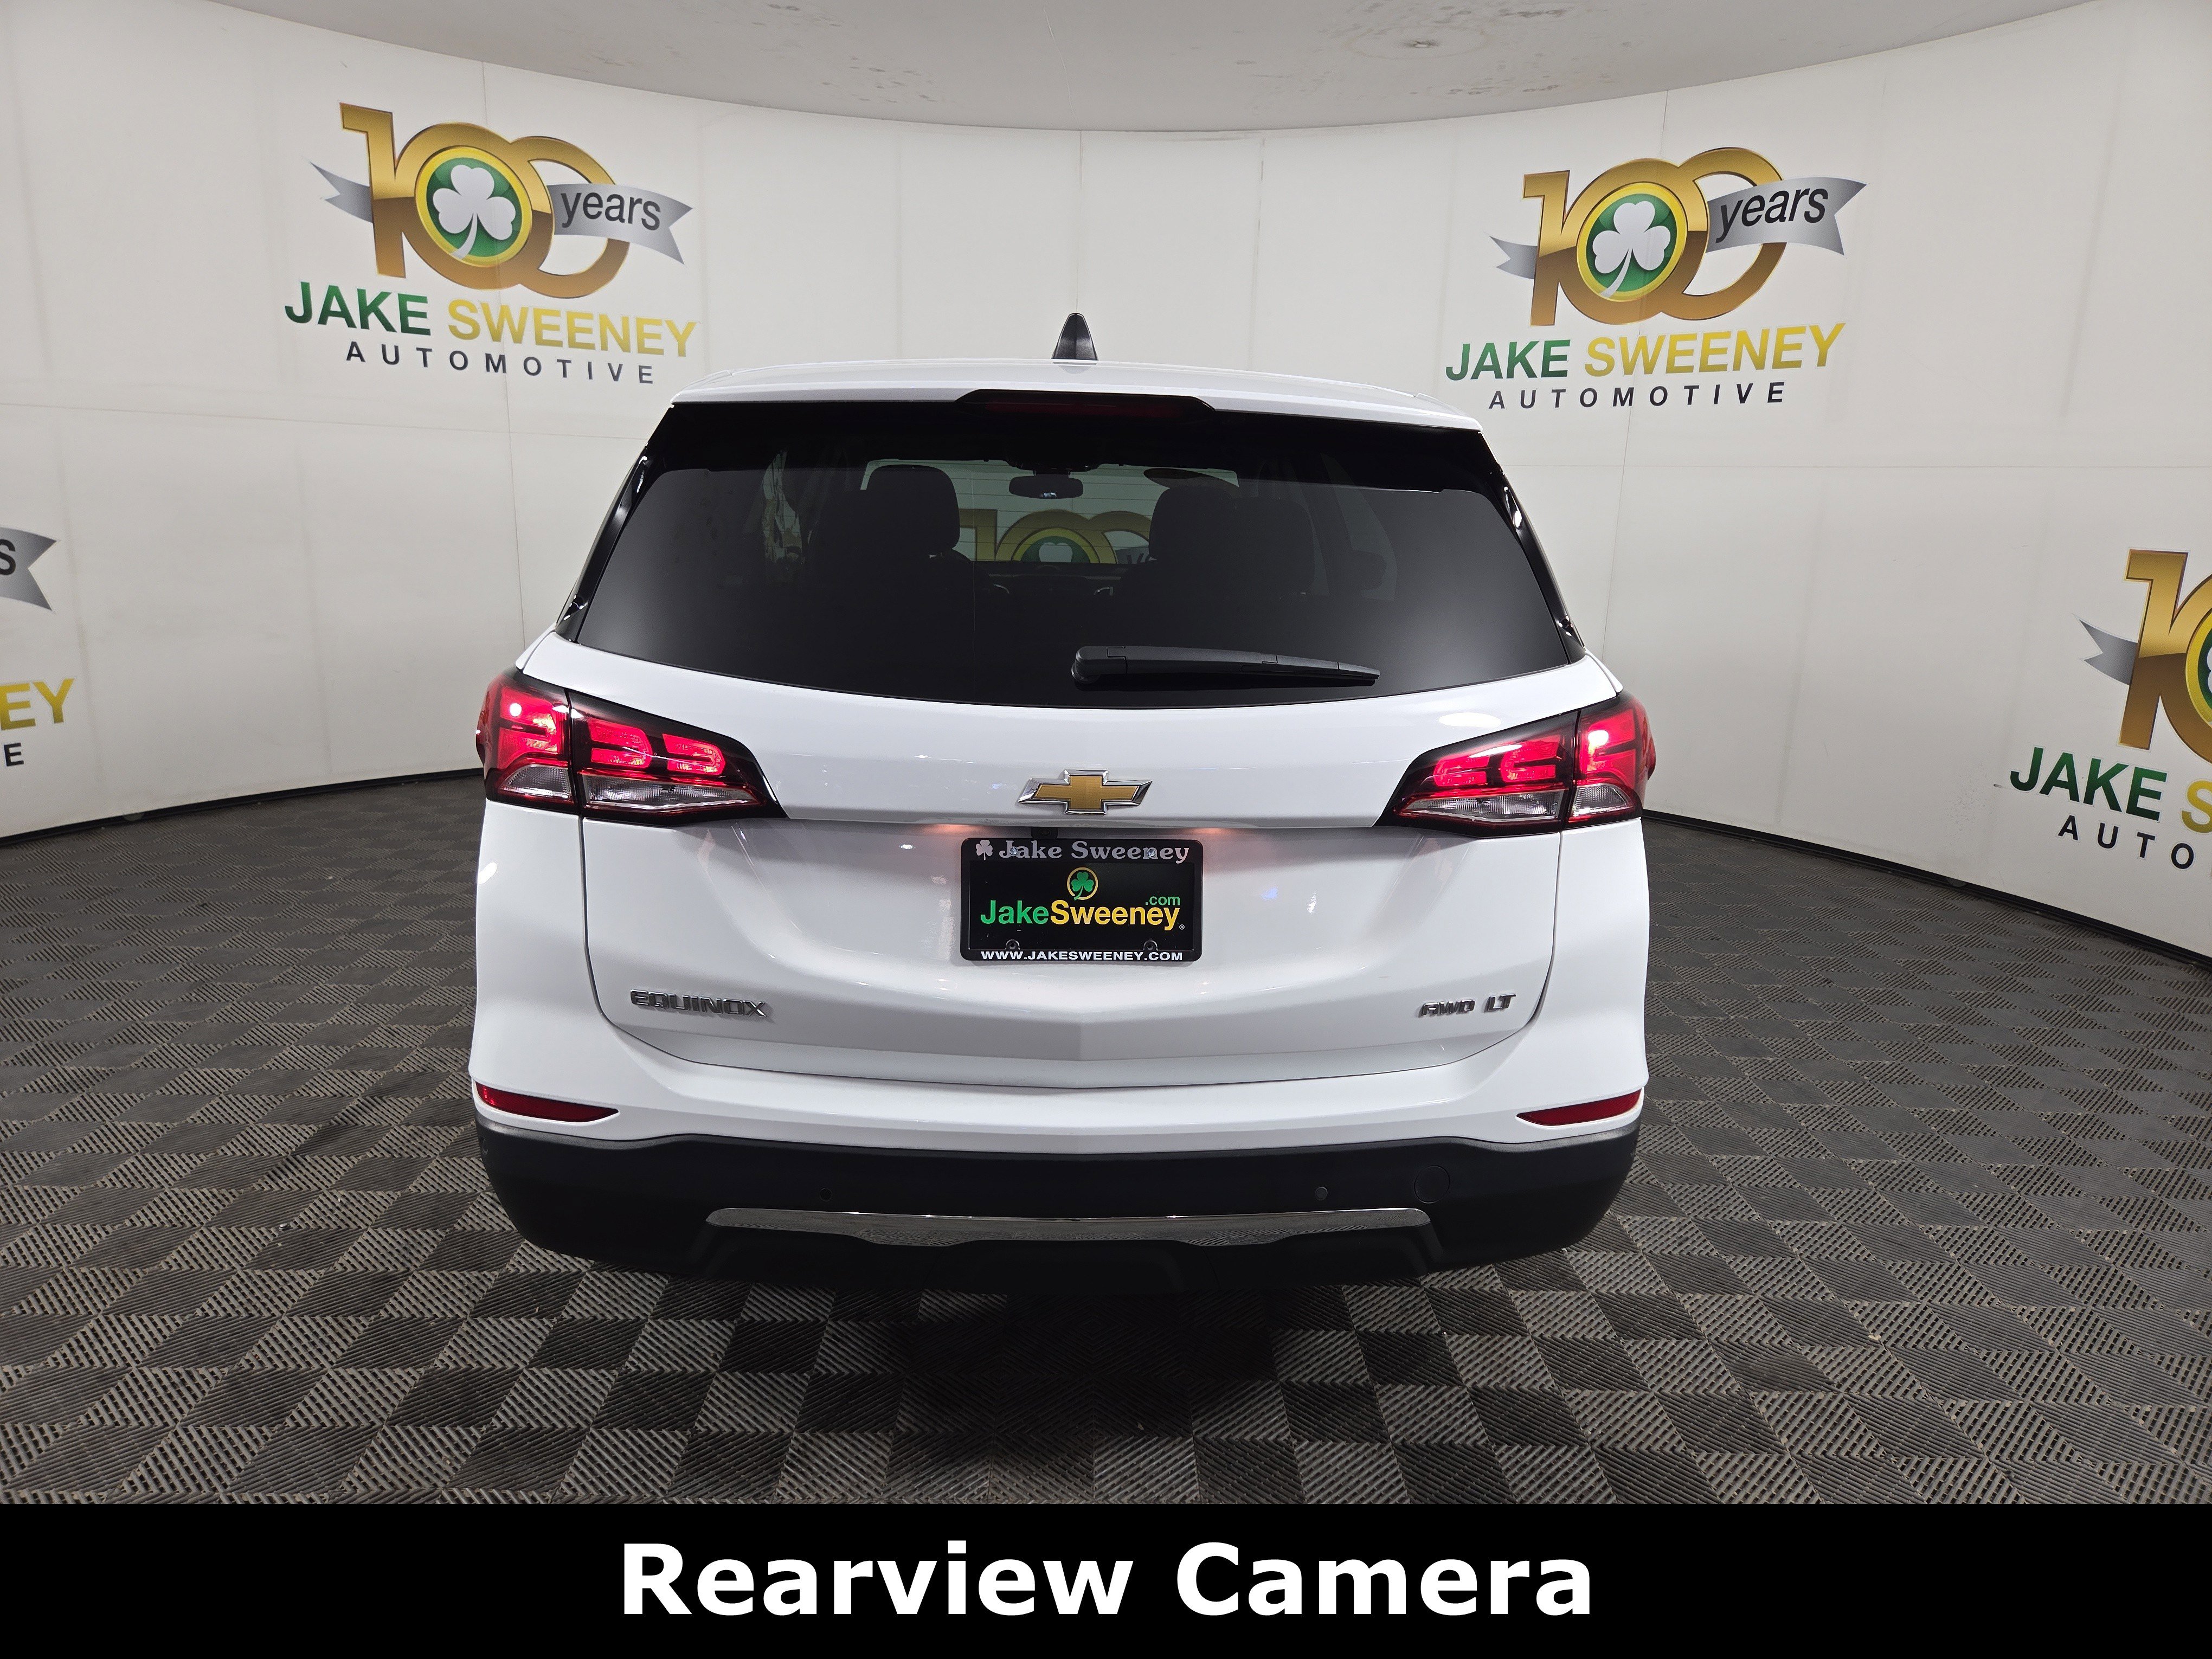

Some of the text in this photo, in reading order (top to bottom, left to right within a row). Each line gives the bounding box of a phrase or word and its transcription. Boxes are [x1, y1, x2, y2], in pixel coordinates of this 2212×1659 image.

[560, 191, 661, 231] years
[1715, 187, 1829, 244] years
[285, 281, 697, 358] JAKE SWEENEY
[346, 340, 653, 384] AUTOMOTIVE
[1445, 322, 1846, 381] JAKE SWEENEY
[1488, 381, 1786, 410] AUTOMOTIVE
[2010, 746, 2168, 821] JAKE
[999, 841, 1189, 864] Jake Sweeney
[981, 951, 1182, 961] WWW.JAKESWEENEY.COM
[631, 989, 766, 1017] EQUINOX
[1418, 993, 1516, 1017] AWD LT
